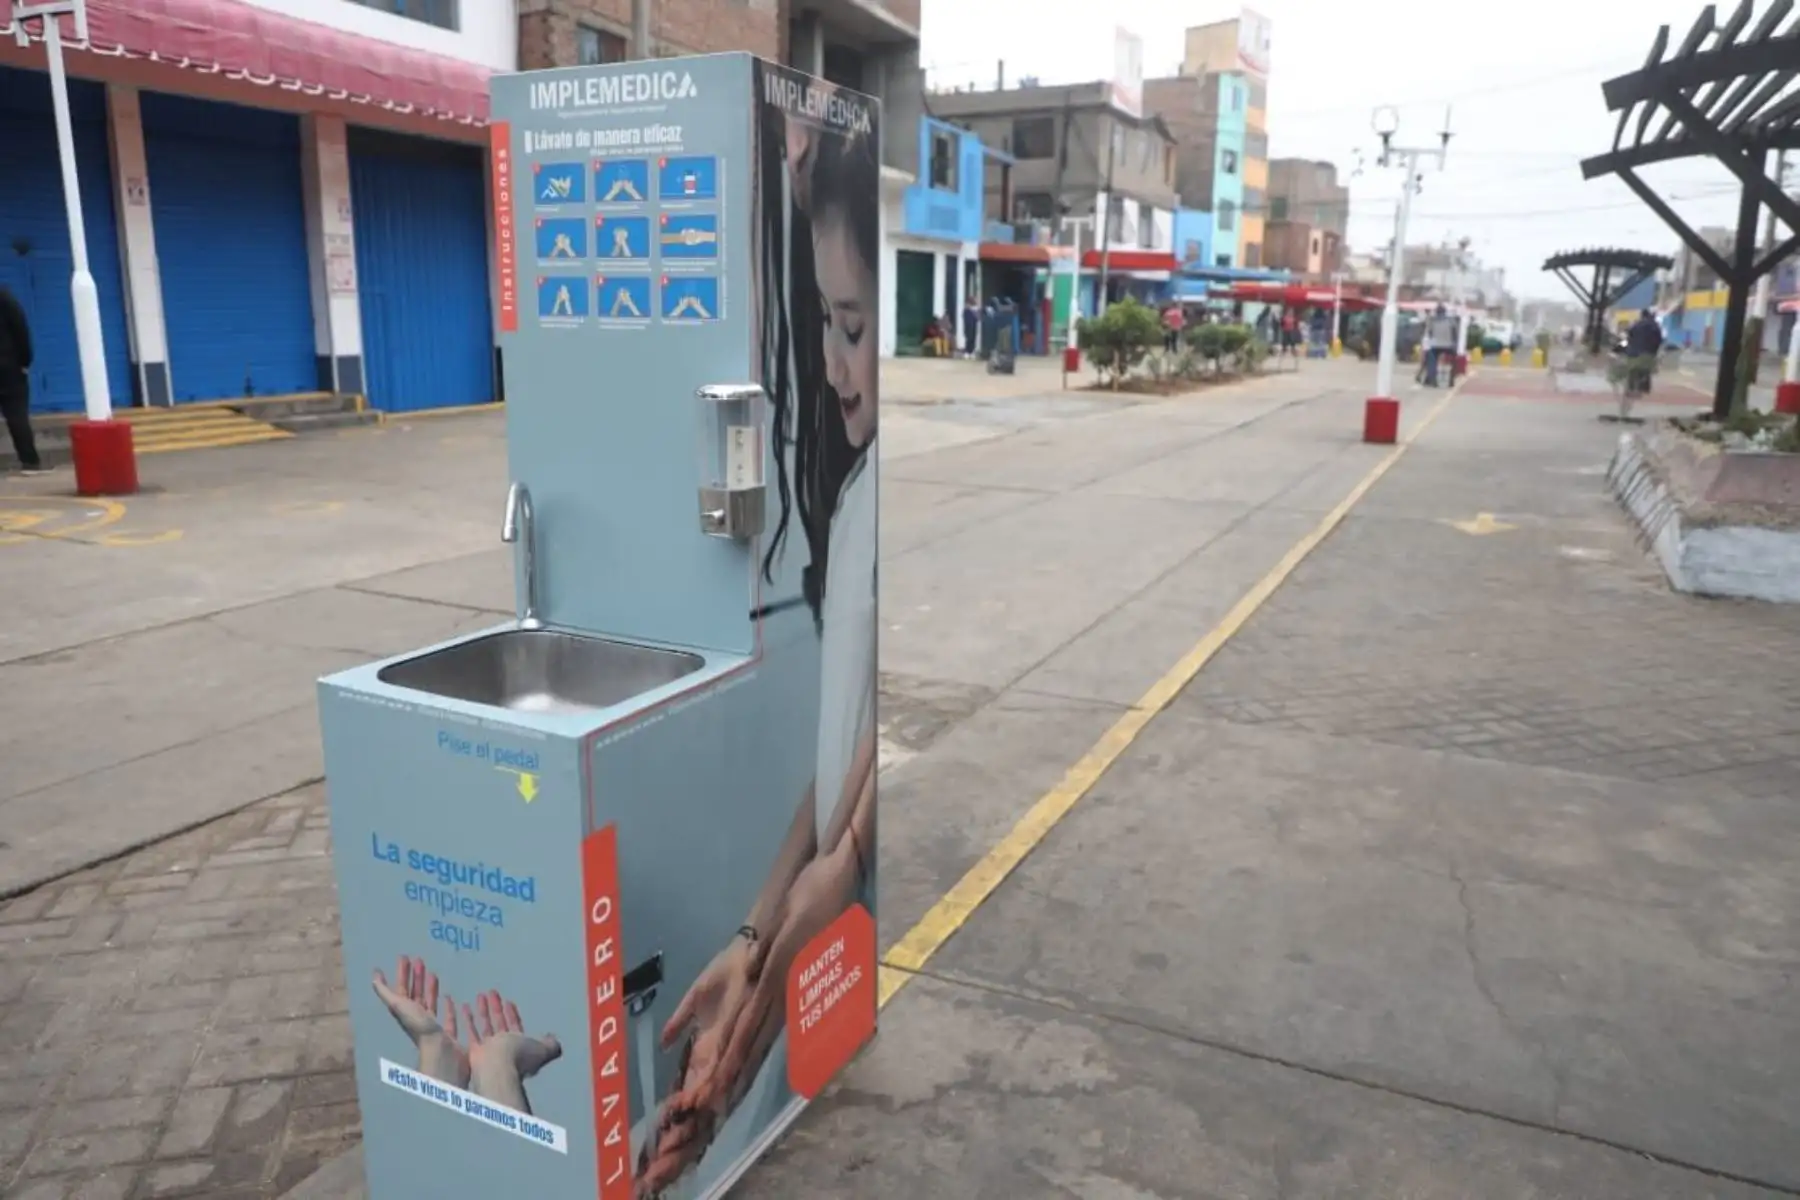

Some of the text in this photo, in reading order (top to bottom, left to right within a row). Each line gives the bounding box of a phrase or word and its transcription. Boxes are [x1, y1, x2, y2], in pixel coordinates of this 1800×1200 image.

[530, 71, 697, 110] IMPLEMEDICA
[765, 72, 872, 134] IMPLEMEDICA
[575, 128, 591, 148] de
[593, 128, 641, 147] manera
[644, 123, 683, 145] eficaz
[498, 148, 513, 311] Instrucciones
[437, 730, 539, 770] Pise el pedal
[372, 831, 535, 903] La seguridad
[404, 880, 504, 929] empieza
[799, 961, 843, 1014] LIMPIAS
[799, 965, 862, 1035] TUS MANOS
[592, 896, 624, 1185] LAVADERO
[388, 1067, 554, 1145] #Este virus lo paramos todos
